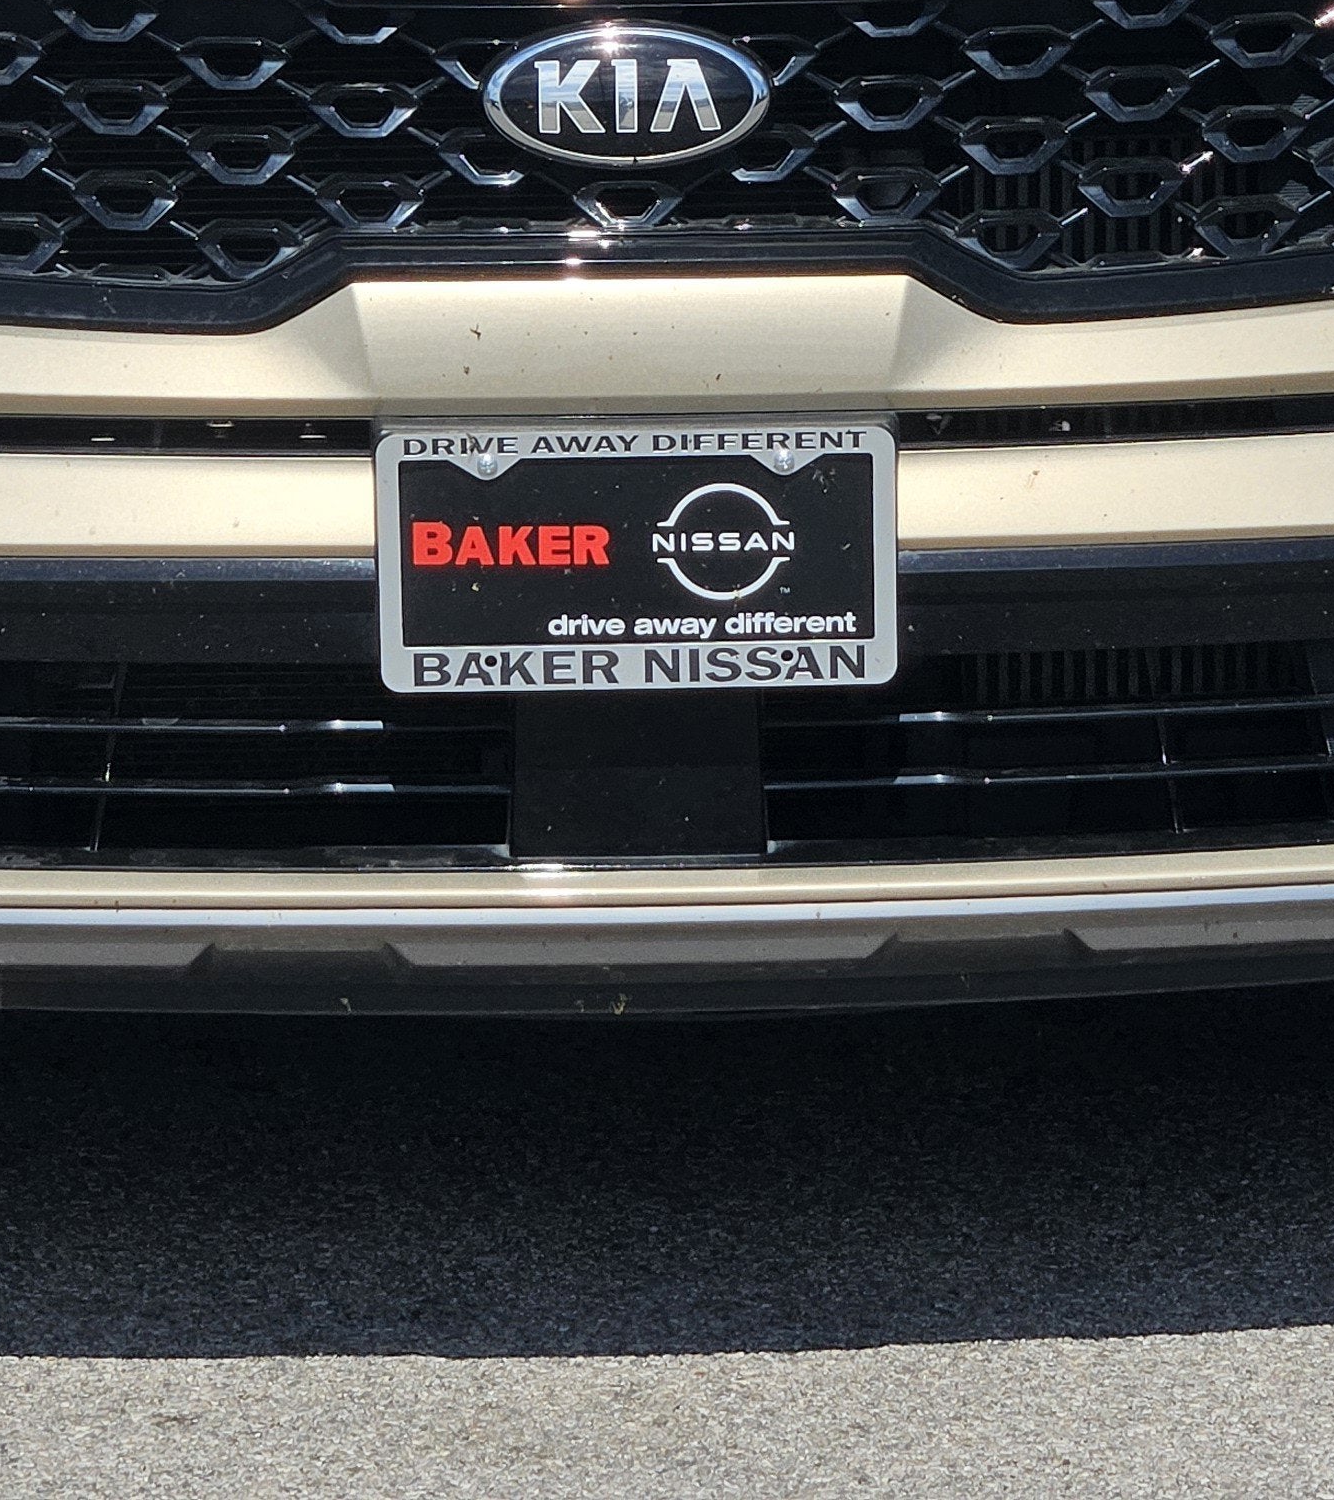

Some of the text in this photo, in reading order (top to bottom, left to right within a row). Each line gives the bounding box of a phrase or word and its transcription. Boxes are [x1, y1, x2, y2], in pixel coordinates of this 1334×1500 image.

[534, 58, 722, 134] KIA
[403, 430, 867, 456] DRIVE AWAY DIFFERENT
[412, 521, 610, 567] BAKER
[652, 531, 795, 553] NISSAN
[548, 611, 857, 640] drive away different
[412, 643, 867, 688] BAKER NISSAN
